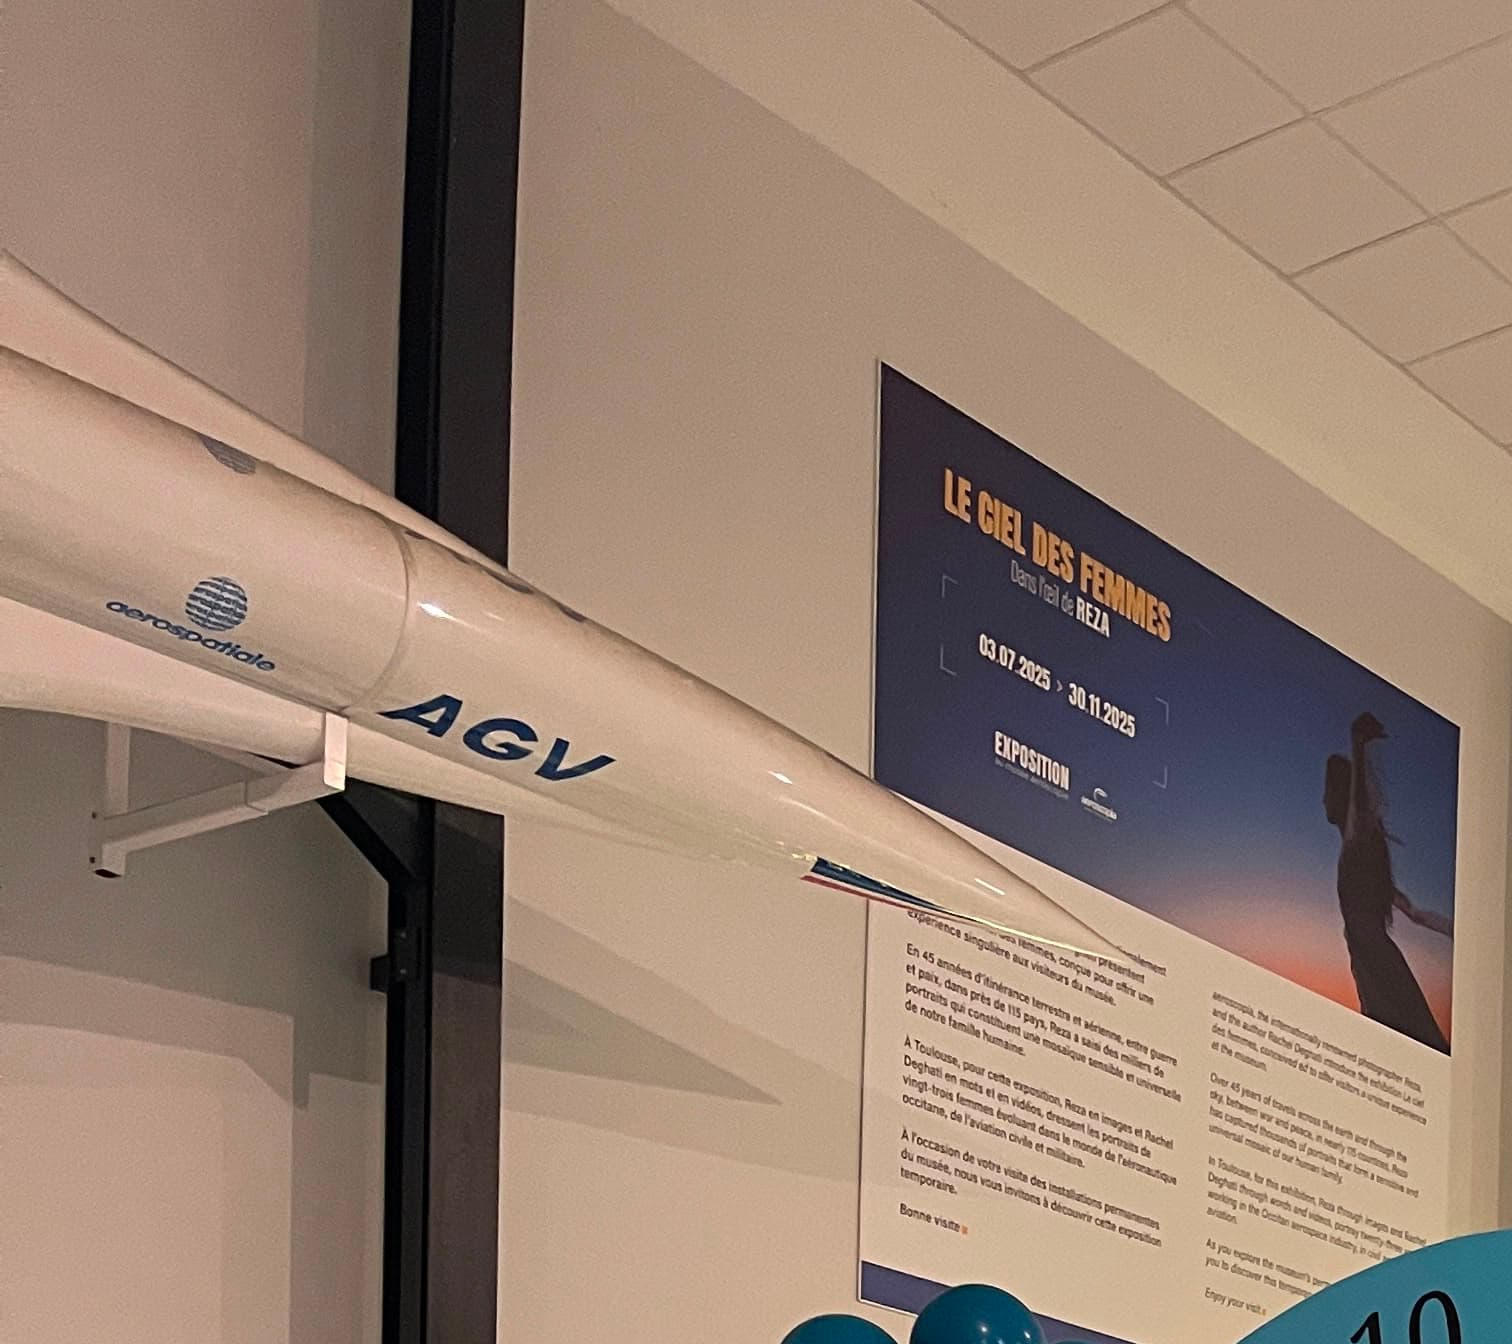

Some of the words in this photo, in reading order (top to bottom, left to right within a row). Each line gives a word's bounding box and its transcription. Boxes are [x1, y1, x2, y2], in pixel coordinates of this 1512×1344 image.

[944, 468, 971, 523] LE
[977, 490, 1025, 555] CIEL
[1032, 522, 1074, 583] DES
[1080, 552, 1170, 641] FEMMES
[106, 601, 276, 671] aerospatiale
[1010, 559, 1037, 594] Dans
[1060, 591, 1074, 616] de
[1076, 596, 1109, 637] REZA
[979, 633, 1050, 690] 03.07.2025
[1068, 682, 1135, 737] 30.11.2025
[377, 694, 616, 781] AGV
[994, 731, 1069, 789] EXPOSITION
[906, 943, 920, 958] En
[922, 951, 935, 964] 45
[937, 958, 972, 980] années
[1073, 1016, 1082, 1026] et
[1126, 1039, 1148, 1054] entre
[1150, 1049, 1177, 1066] guerre
[1012, 954, 1029, 968] aux
[1031, 963, 1069, 985] visiteurs
[1071, 979, 1083, 992] du
[1094, 972, 1114, 987] pour
[1138, 992, 1154, 1005] une
[905, 999, 917, 1013] de
[920, 1007, 946, 1025] notre
[948, 1015, 981, 1038] famille
[906, 964, 916, 975] et
[944, 979, 968, 996] dans
[970, 991, 991, 1006] près
[994, 999, 1005, 1012] de
[1008, 1004, 1021, 1019] 115
[1050, 1021, 1071, 1040] Reza
[1103, 1045, 1119, 1059] des
[1154, 1066, 1164, 1078] de
[950, 1001, 966, 1014] qui
[968, 1008, 1021, 1036] constituent
[1023, 1032, 1041, 1044] une
[1126, 1073, 1134, 1082] et
[903, 1075, 953, 1102] vingt-trois
[956, 1092, 994, 1116] femmes
[1038, 1125, 1060, 1142] dans
[1062, 1132, 1070, 1146] le
[1072, 1139, 1103, 1157] monde
[1104, 1150, 1116, 1162] de
[904, 1035, 911, 1048] À
[963, 1061, 985, 1076] pour
[1065, 1098, 1086, 1116] Reza
[1088, 1110, 1099, 1120] en
[1101, 1115, 1132, 1134] images
[1134, 1128, 1143, 1138] et
[1145, 1129, 1173, 1149] Rachel
[945, 1073, 957, 1083] en
[960, 1078, 983, 1094] mots
[986, 1088, 995, 1099] et
[997, 1093, 1009, 1104] en
[1046, 1111, 1085, 1133] dressent
[1087, 1124, 1100, 1140] les
[1140, 1147, 1151, 1158] de
[950, 1110, 962, 1123] de
[1008, 1133, 1033, 1149] civile
[1035, 1143, 1044, 1153] et
[901, 1128, 909, 1141] À
[962, 1151, 975, 1164] de
[977, 1158, 1001, 1173] votre
[1004, 1168, 1028, 1183] visite
[1030, 1176, 1047, 1190] des
[901, 1148, 914, 1162] du
[954, 1168, 978, 1184] nous
[980, 1177, 1002, 1192] vous
[1004, 1185, 1041, 1206] invitons
[1050, 1201, 1093, 1222] découvrir
[1118, 1226, 1161, 1247] exposition
[900, 1203, 932, 1223] Bonne
[934, 1217, 960, 1232] visite
